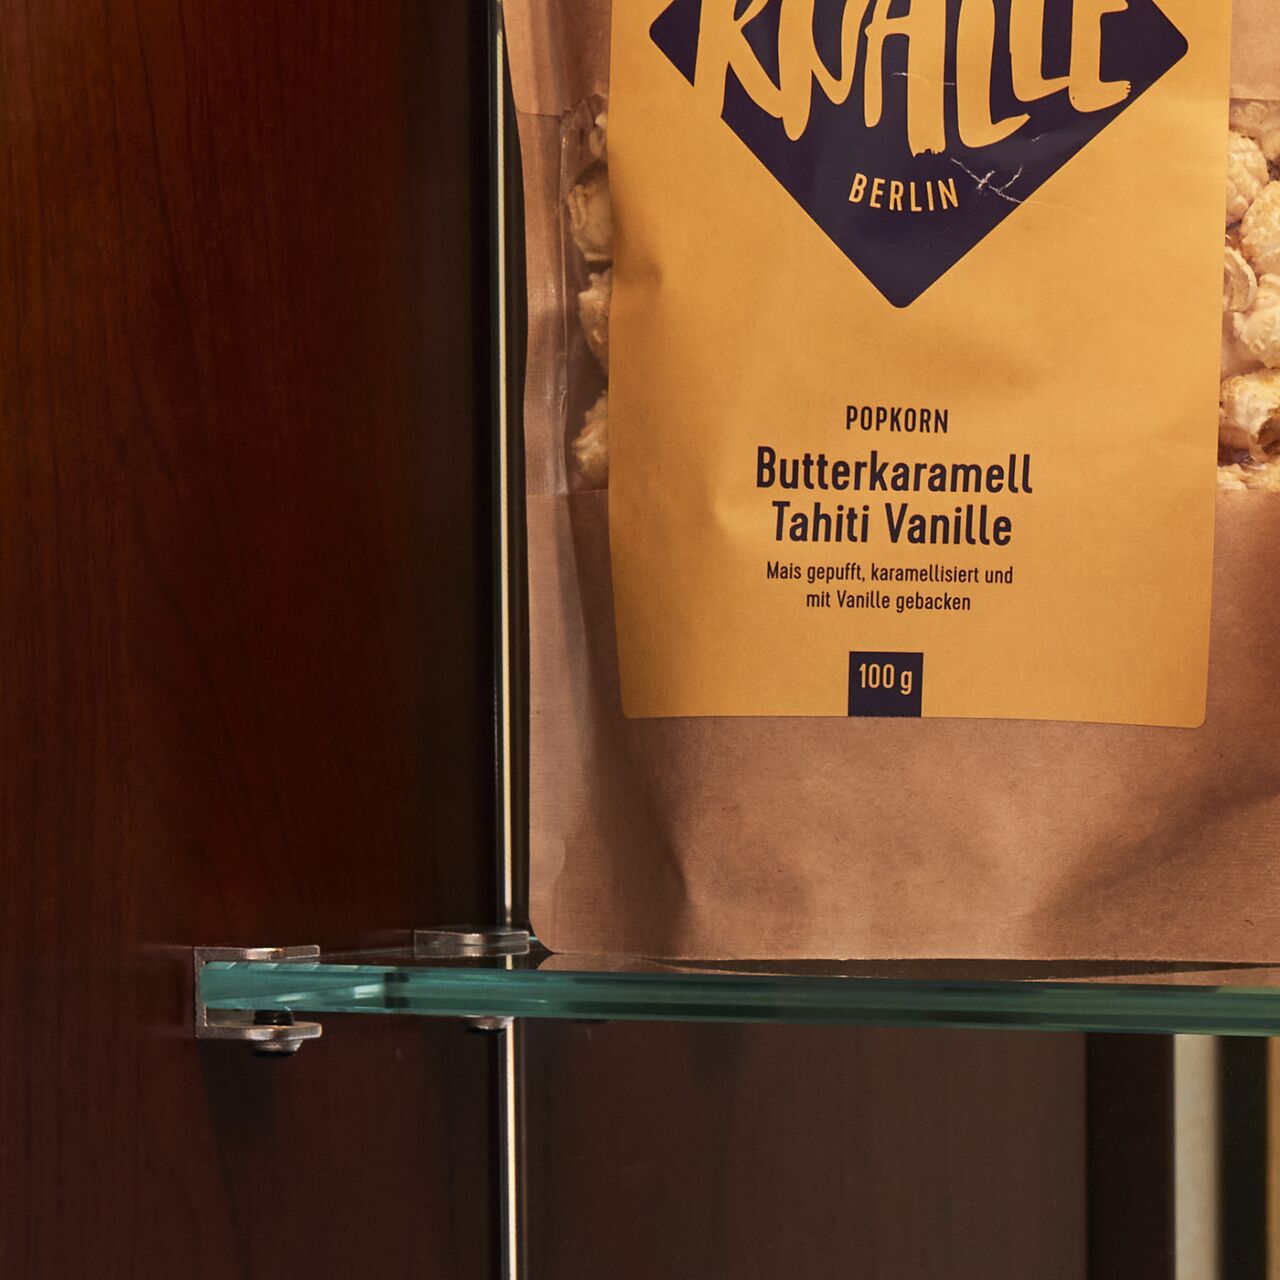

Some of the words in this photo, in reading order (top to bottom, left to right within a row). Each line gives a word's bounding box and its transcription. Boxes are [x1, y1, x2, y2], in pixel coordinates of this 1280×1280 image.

[848, 172, 959, 213] BERLIN
[846, 405, 949, 433] POPKORN
[756, 446, 1033, 494] Butterkaramell
[772, 501, 869, 543] Tahiti
[884, 502, 1013, 546] Vanille
[766, 561, 801, 580] Mais
[806, 563, 866, 583] gepufft,
[870, 563, 979, 583] karamellisiert
[984, 566, 1014, 584] und
[806, 591, 831, 608] mit
[836, 590, 891, 609] Vanille
[895, 592, 971, 613] gebacken
[859, 663, 895, 689] 100
[900, 669, 914, 696] g
